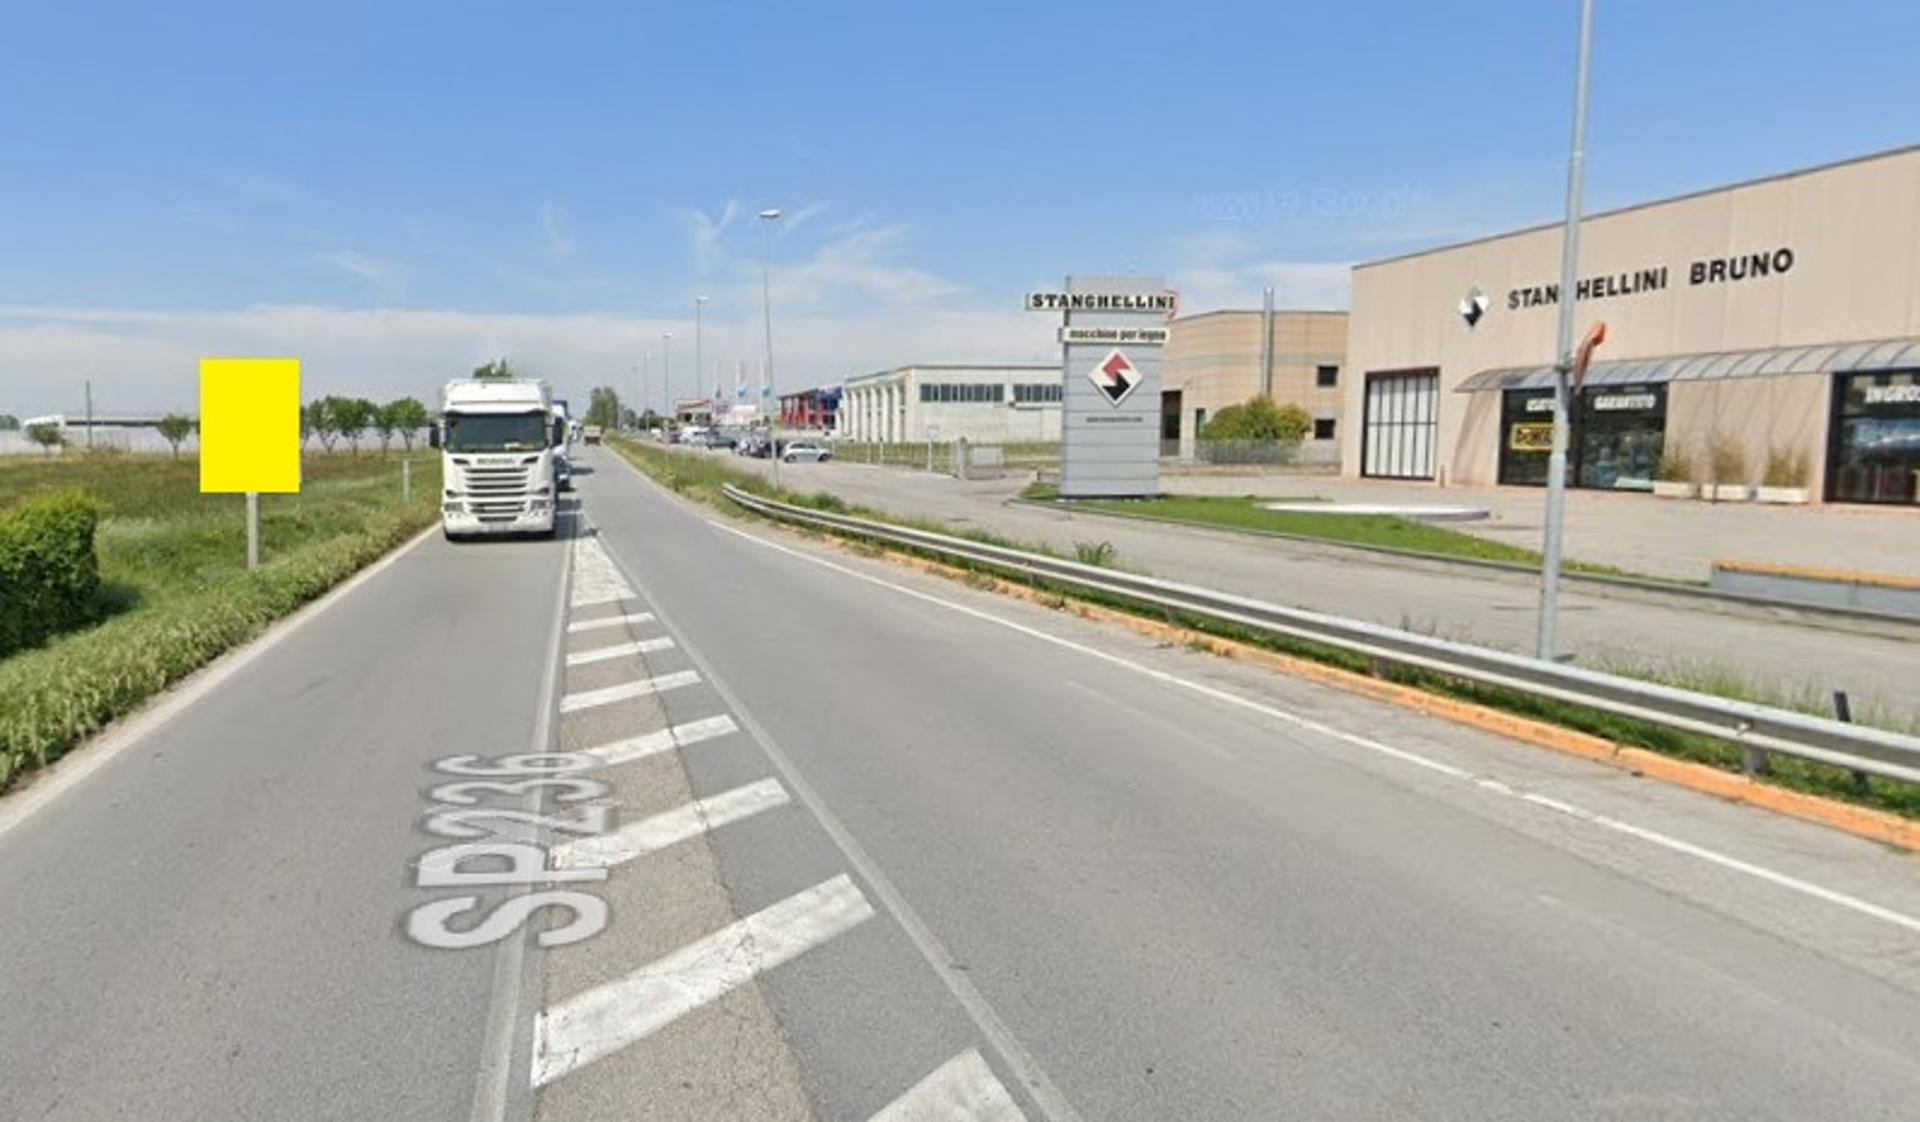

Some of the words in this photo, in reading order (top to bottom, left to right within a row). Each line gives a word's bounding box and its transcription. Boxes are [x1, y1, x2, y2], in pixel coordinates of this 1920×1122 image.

[1508, 267, 1667, 310] STANHELLINI
[1690, 248, 1795, 285] BRUNO
[1032, 293, 1175, 310] STANGHELLINI
